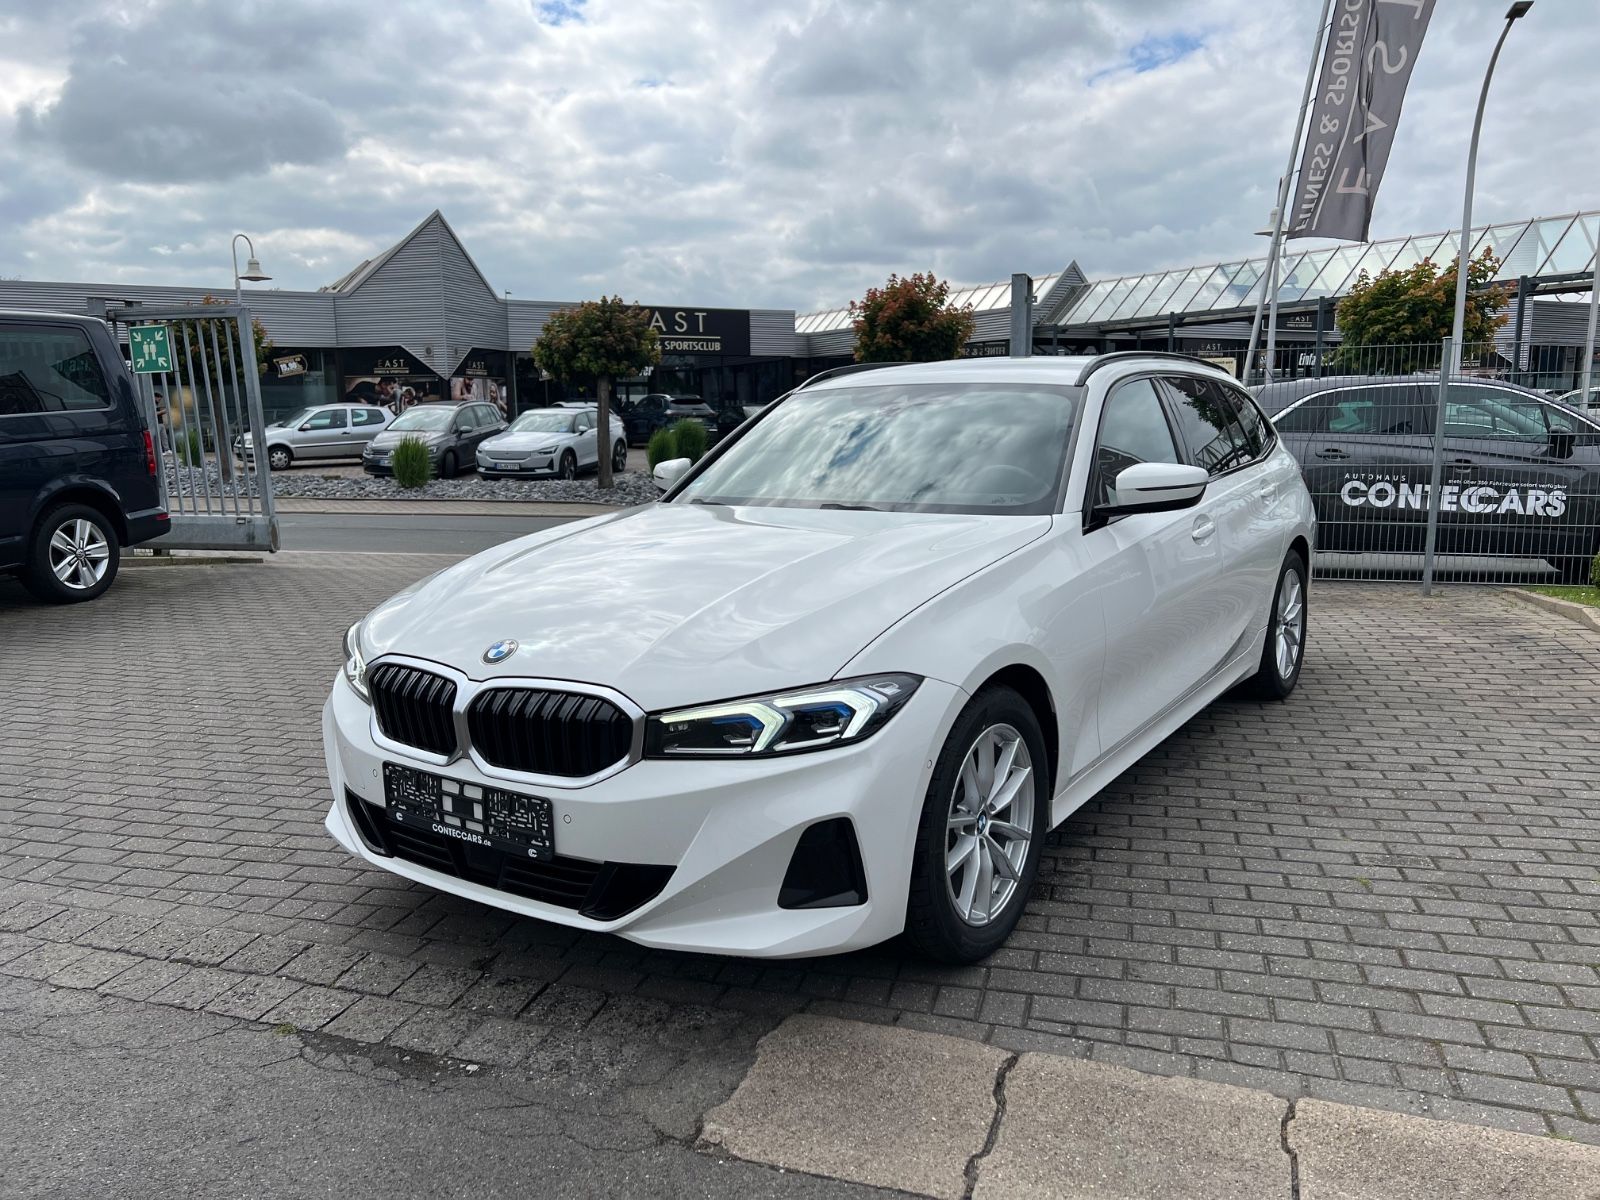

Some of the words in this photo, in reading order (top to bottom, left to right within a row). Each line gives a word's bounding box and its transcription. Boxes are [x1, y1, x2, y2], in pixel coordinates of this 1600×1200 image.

[648, 310, 707, 332] AST
[664, 341, 721, 351] SPORTSCLUB
[377, 359, 405, 368] EAST
[1344, 472, 1407, 481] AUTOHAUS
[432, 823, 492, 847] CONTECCARS.de
